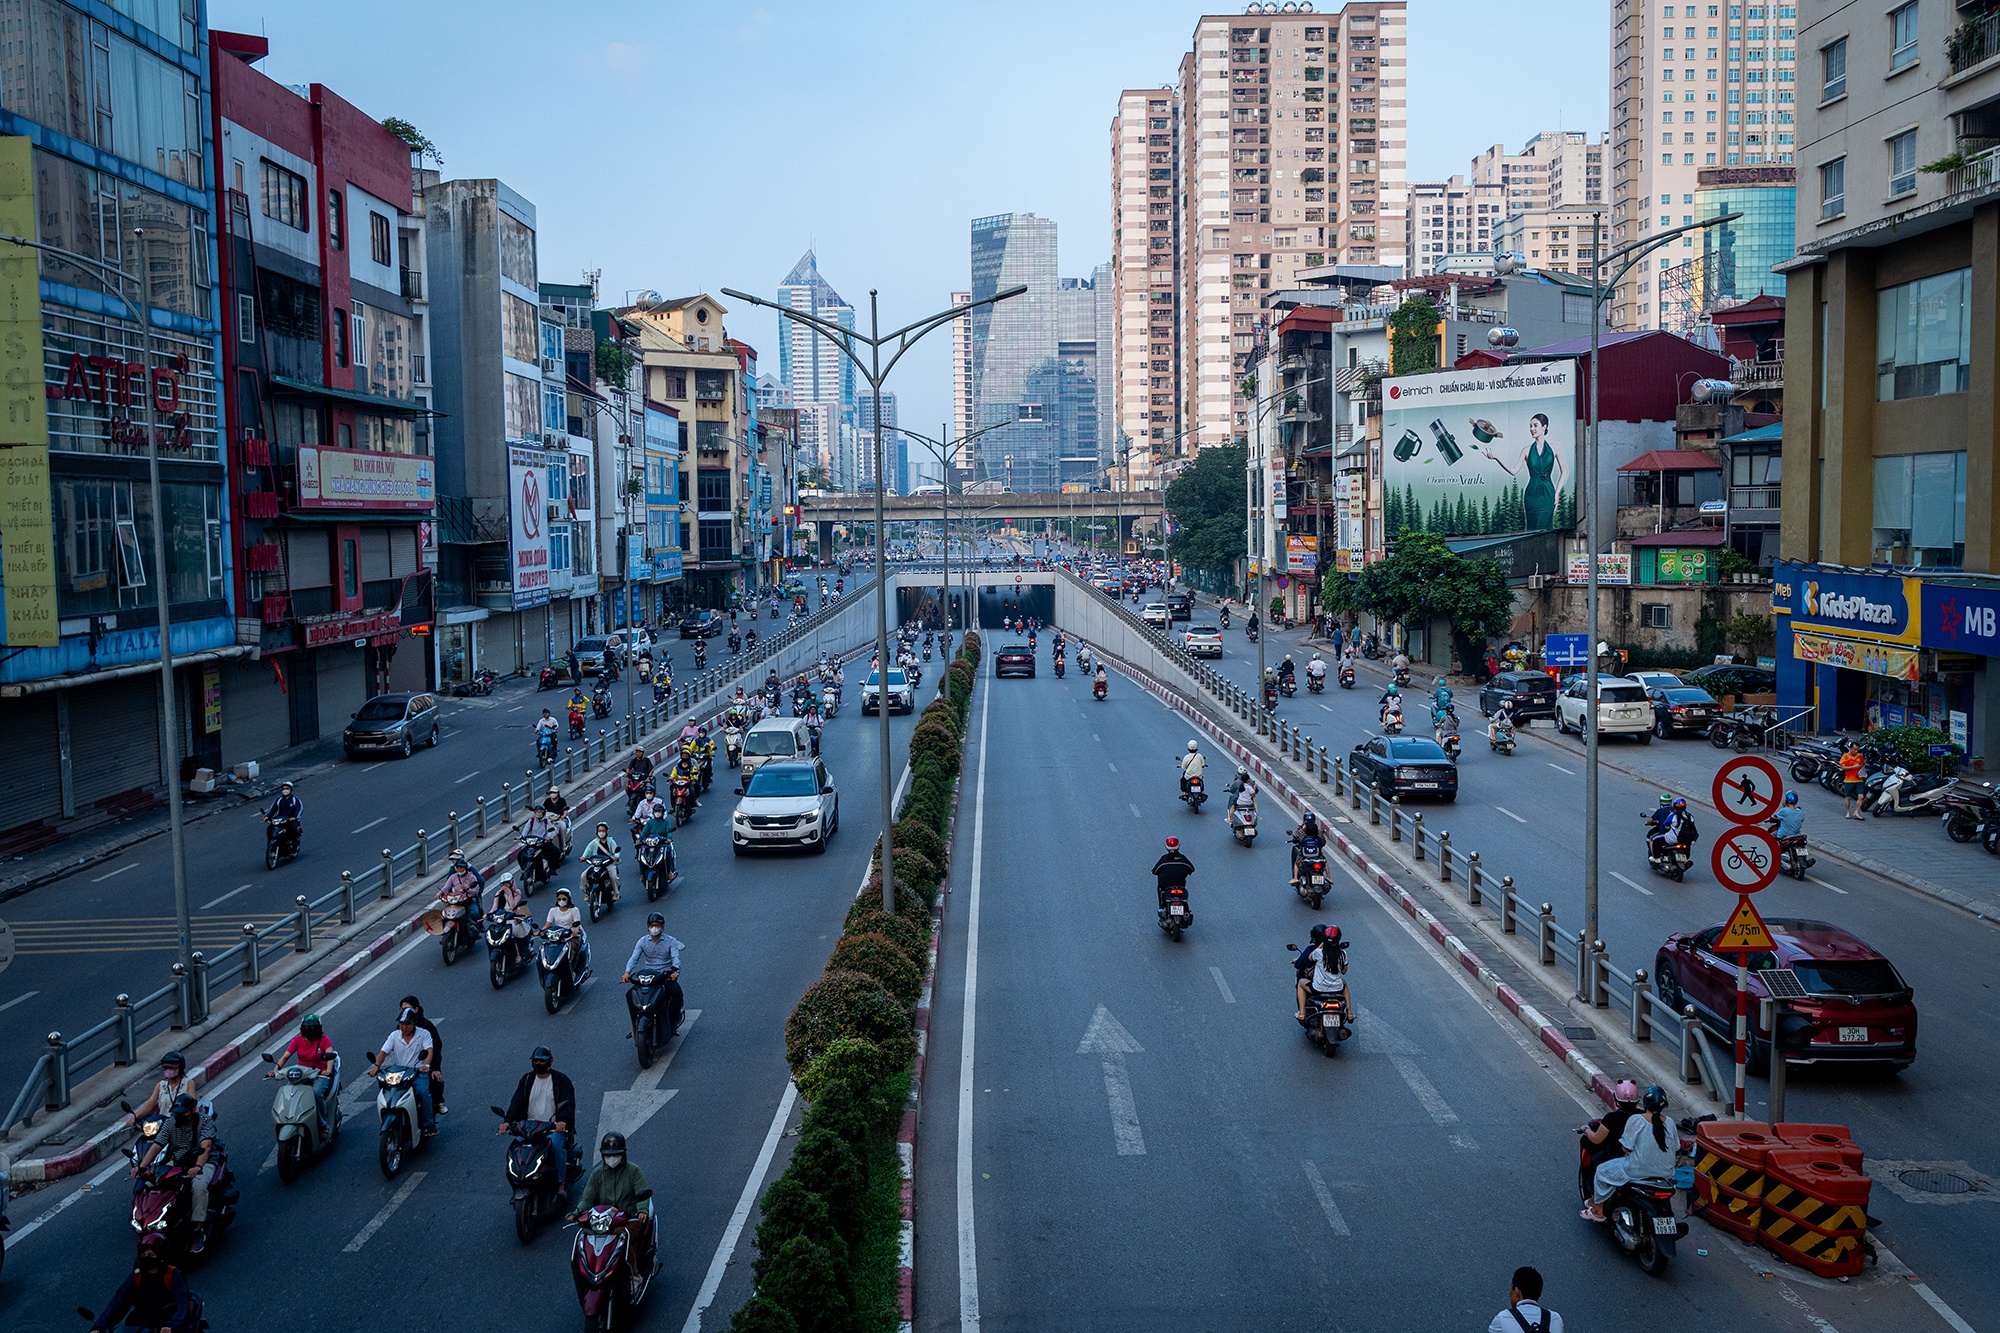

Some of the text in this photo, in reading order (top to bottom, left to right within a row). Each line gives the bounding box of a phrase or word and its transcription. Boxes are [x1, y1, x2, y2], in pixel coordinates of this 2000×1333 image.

[1716, 168, 1762, 180] LICOGI
[1767, 168, 1780, 179] 13
[1402, 385, 1433, 397] elmich
[1440, 382, 1459, 393] CHUẨN
[1460, 381, 1475, 392] CHÂU
[1476, 380, 1485, 391] ÂU
[1489, 379, 1496, 390] VÌ
[1525, 376, 1536, 386] GIA
[1537, 374, 1552, 385] ĐÌNH
[1552, 373, 1567, 385] VIỆT
[31, 455, 45, 467] ĐÁ
[354, 458, 364, 472] BIA
[376, 457, 385, 474] HÀ
[385, 458, 395, 477] NỘI
[7, 471, 39, 486] ỐP LÁT
[302, 480, 319, 489] HABECO
[331, 475, 345, 493] NHÀ
[346, 476, 363, 494] HÀNG
[364, 477, 380, 495] HÙNG
[381, 478, 393, 497] HIỆP
[7, 497, 43, 514] THIẾT BỊ
[7, 517, 43, 530] VỆ SINH
[10, 540, 45, 556] THIẾT BỊ
[8, 555, 48, 572] NHÀ BẾP
[518, 549, 533, 569] MINH
[519, 569, 549, 588] COMPUTER
[11, 585, 48, 601] NHẬP
[13, 604, 49, 621] KHẨU
[1820, 591, 1893, 625] KidsPlaza
[1964, 605, 1997, 638] MB
[101, 630, 160, 656] ITALY
[1731, 924, 1760, 936] 4,75m
